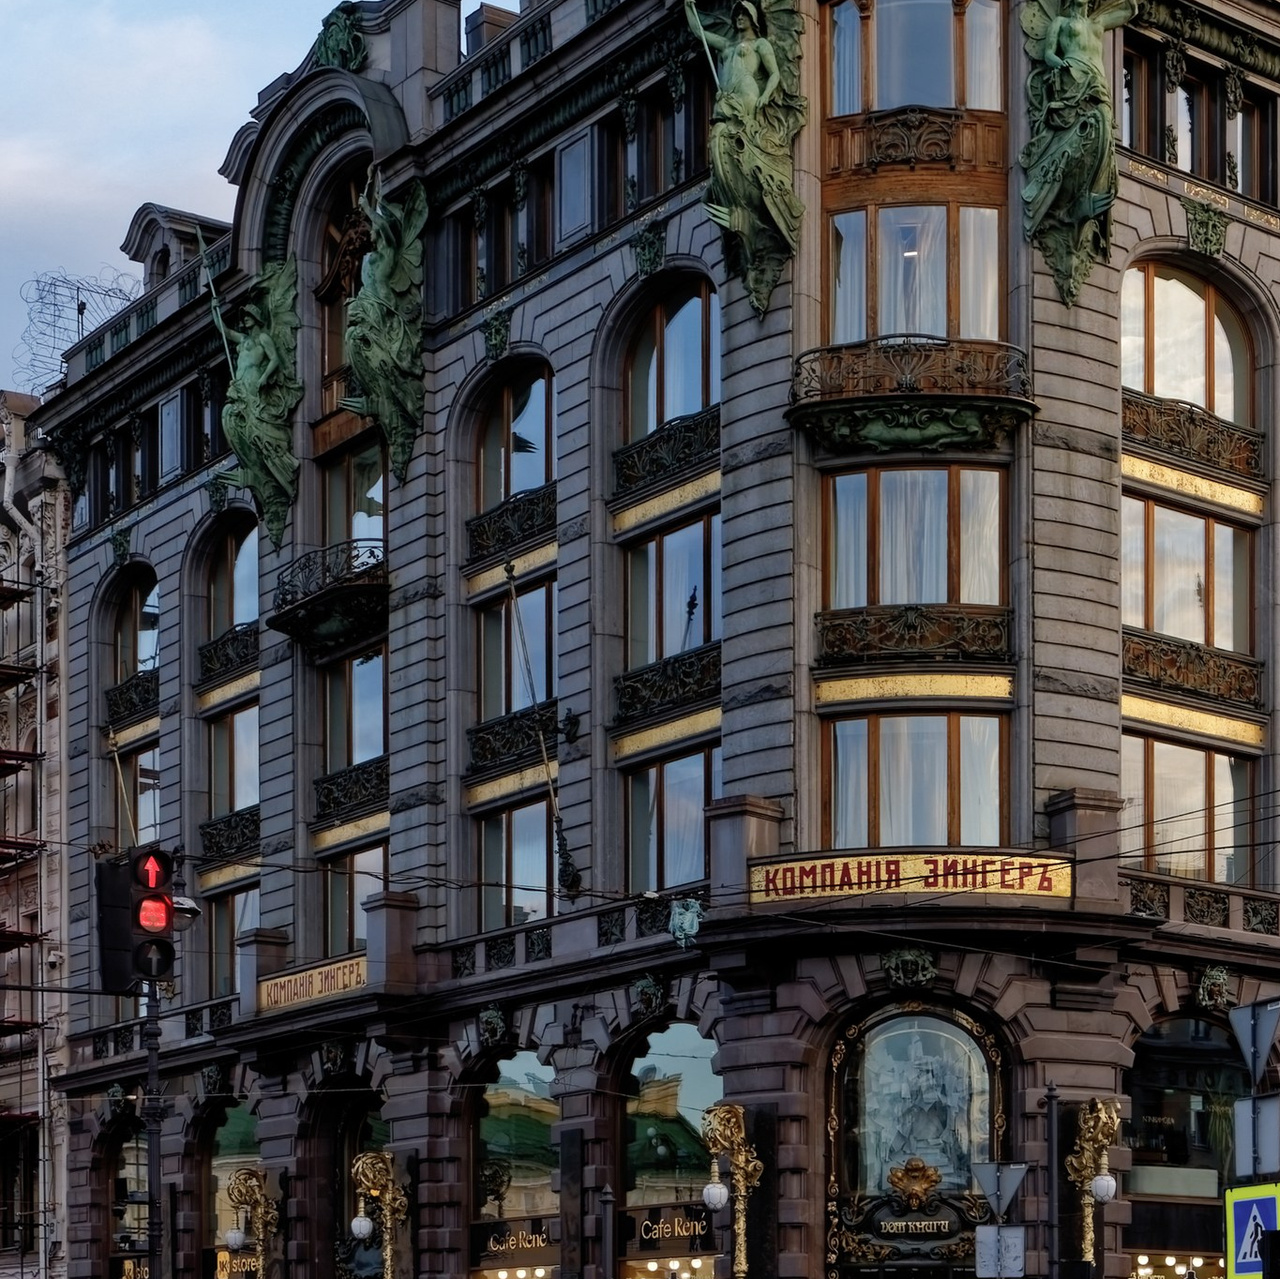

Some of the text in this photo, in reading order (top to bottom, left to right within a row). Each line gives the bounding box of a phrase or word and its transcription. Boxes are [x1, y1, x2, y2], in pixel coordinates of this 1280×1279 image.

[764, 858, 1053, 897] КОМПАНІЯ ЗИНГЕРЪ
[490, 1226, 547, 1251] Cafe René
[641, 1212, 708, 1240] Cafe René
[232, 1256, 257, 1273] store
